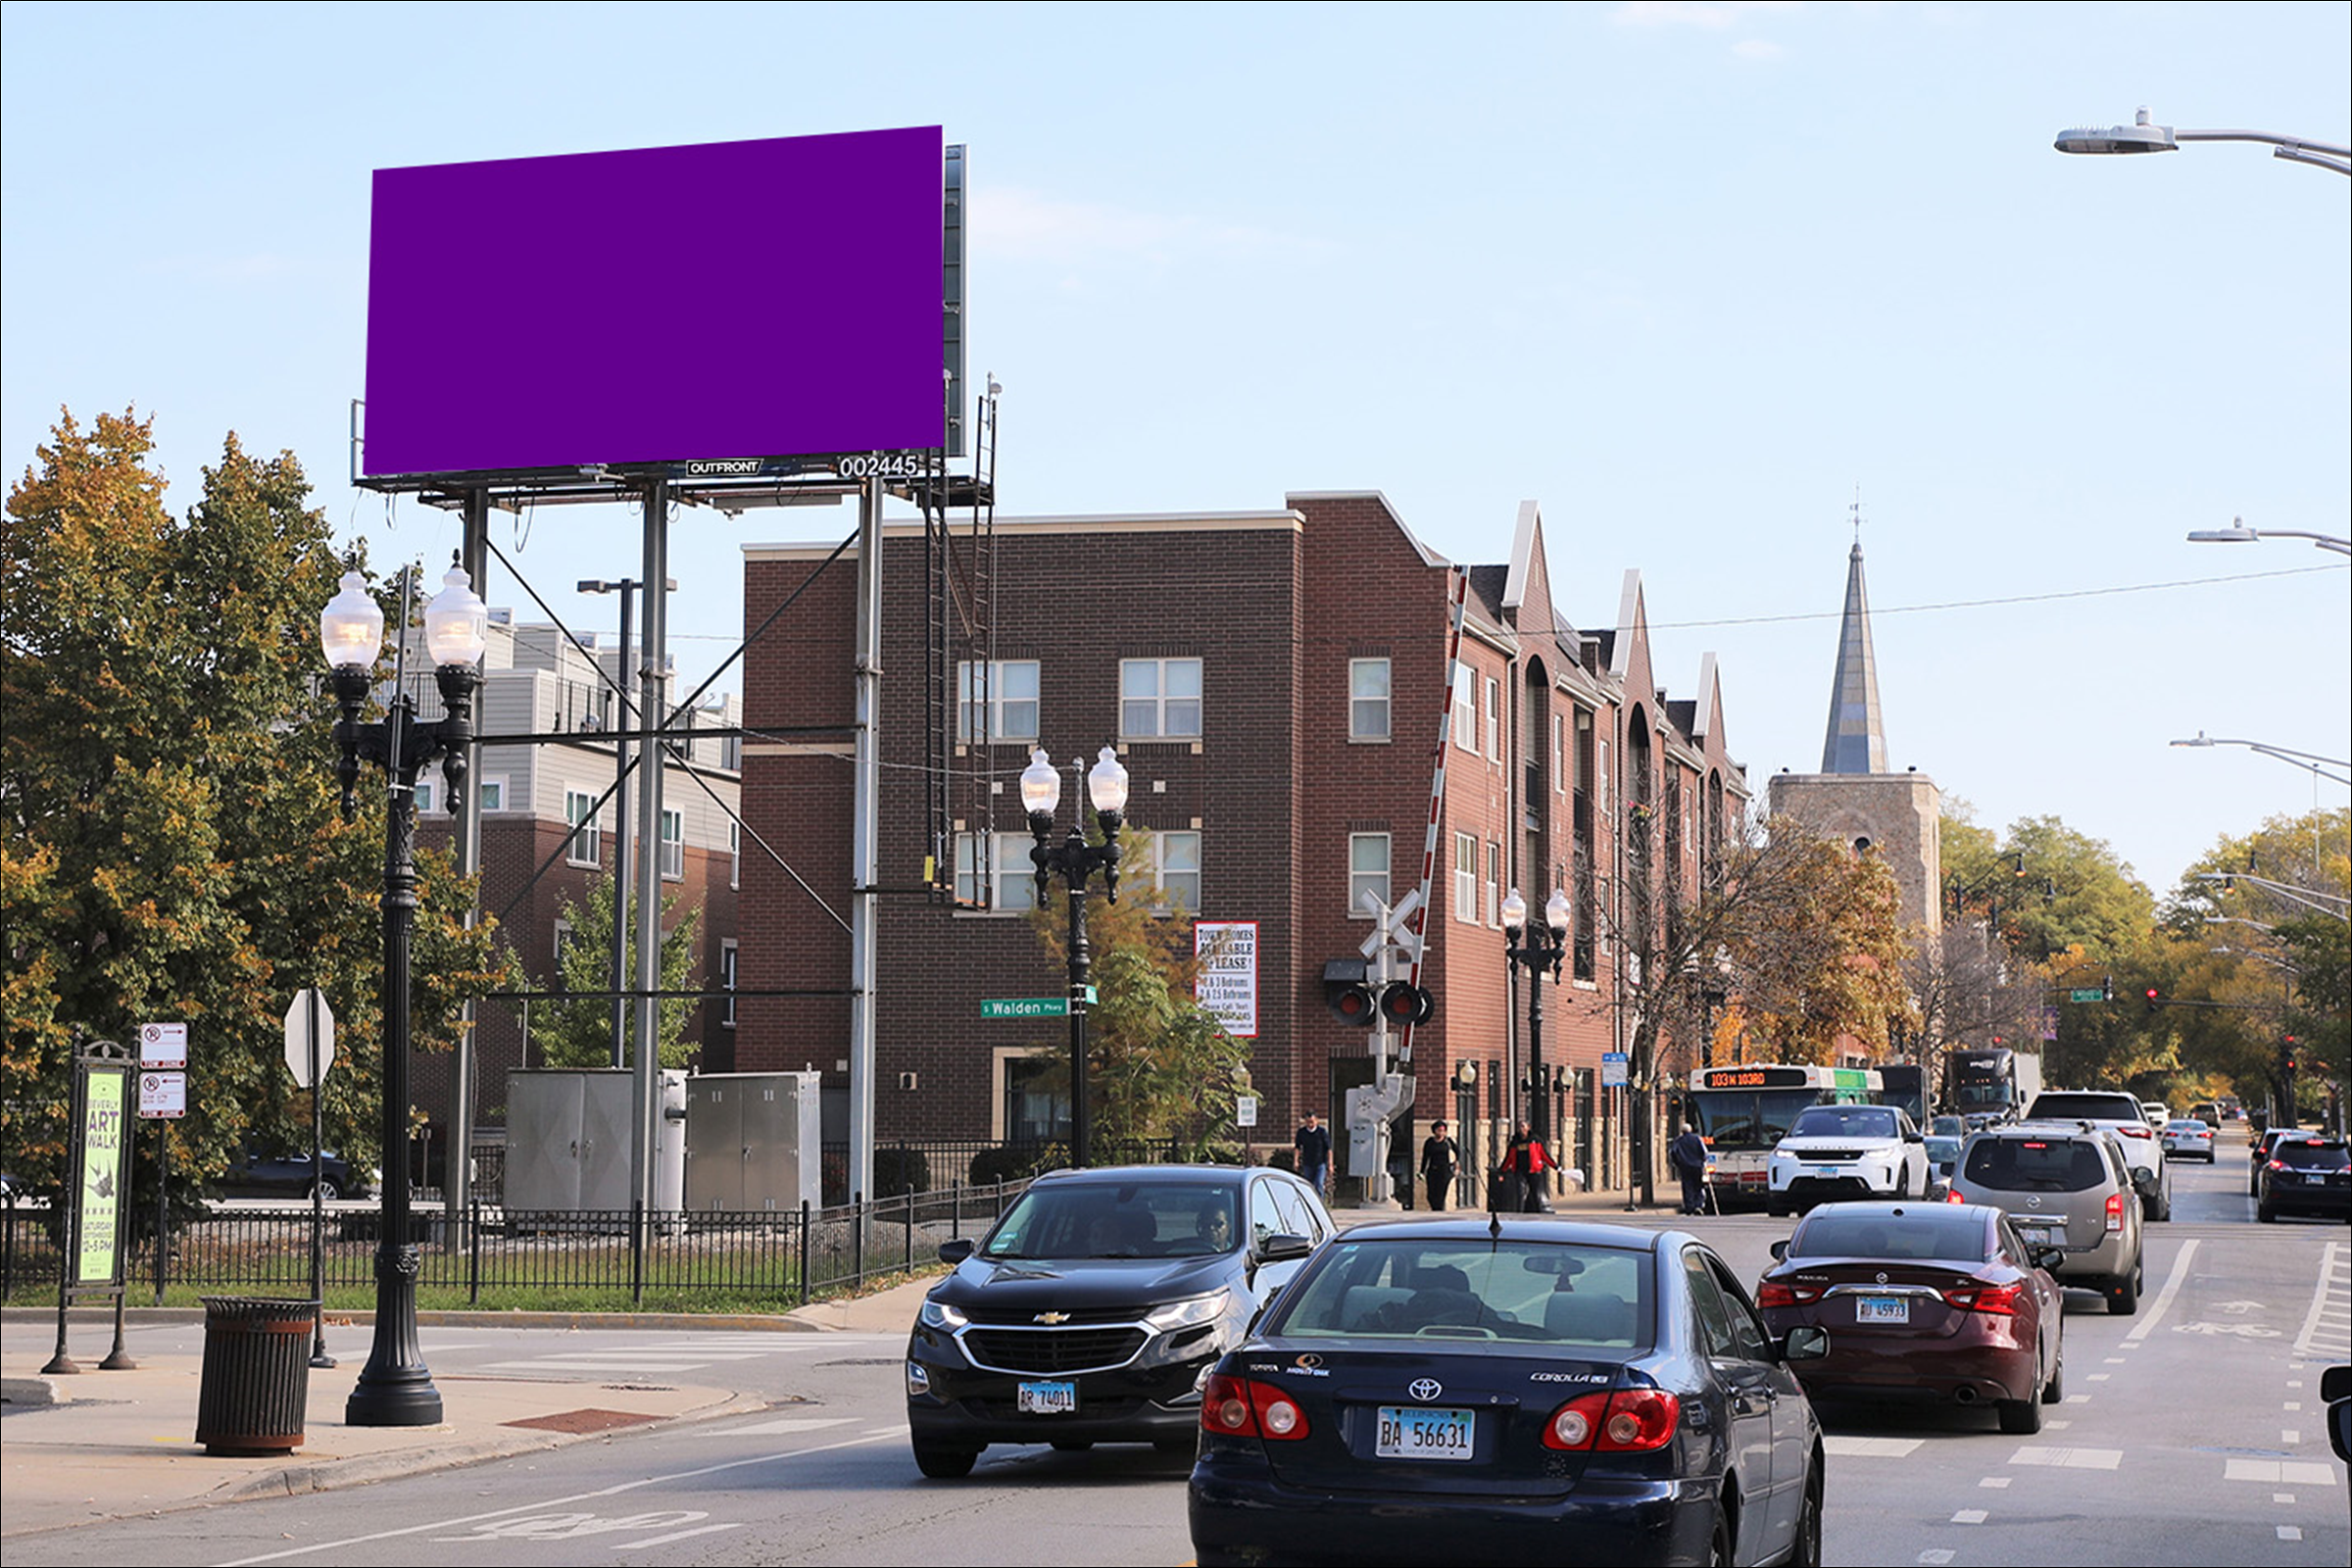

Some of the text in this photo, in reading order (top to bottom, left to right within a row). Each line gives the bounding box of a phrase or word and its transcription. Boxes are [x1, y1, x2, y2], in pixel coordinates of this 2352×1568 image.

[691, 462, 759, 474] OUTFRONT
[840, 456, 917, 477] 002445
[992, 1002, 1041, 1014] Walden
[1711, 1072, 1729, 1087] 103
[1738, 1072, 1765, 1086] 103RD
[88, 1110, 120, 1132] ART
[86, 1134, 118, 1150] WALK
[1530, 1372, 1590, 1383] COROLLA
[1039, 1390, 1072, 1407] 74011
[1380, 1421, 1468, 1448] BA 56631
